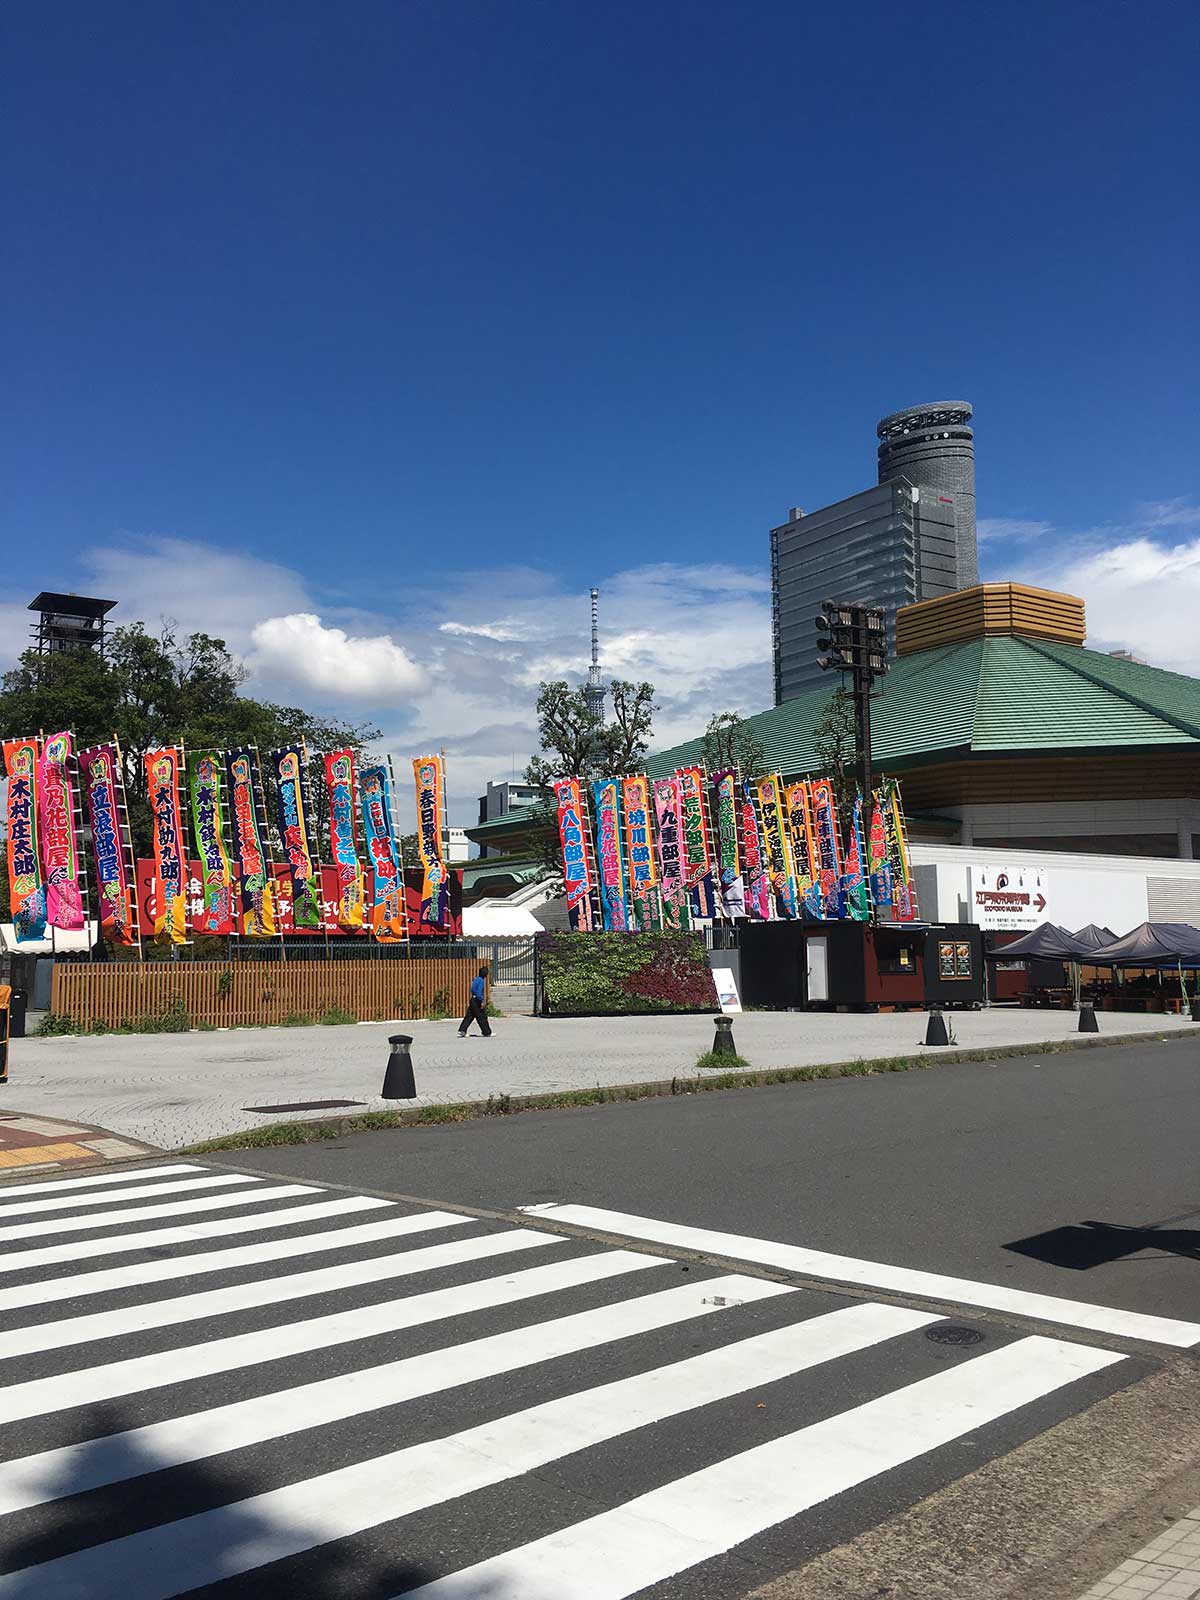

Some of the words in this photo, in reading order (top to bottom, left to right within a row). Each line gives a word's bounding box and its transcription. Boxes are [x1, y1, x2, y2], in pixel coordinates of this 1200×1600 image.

[10, 779, 36, 876] 木村庄太郎
[43, 764, 69, 867] 貴乃花部屋
[91, 784, 120, 882] 立浪部屋
[562, 809, 587, 880] 八角部屋
[600, 809, 620, 886] 貴乃花部屋
[628, 809, 652, 881] 境川部屋
[660, 809, 682, 879] 九重部屋
[789, 809, 810, 876] 錣山部屋
[817, 808, 834, 870] 尾車部屋
